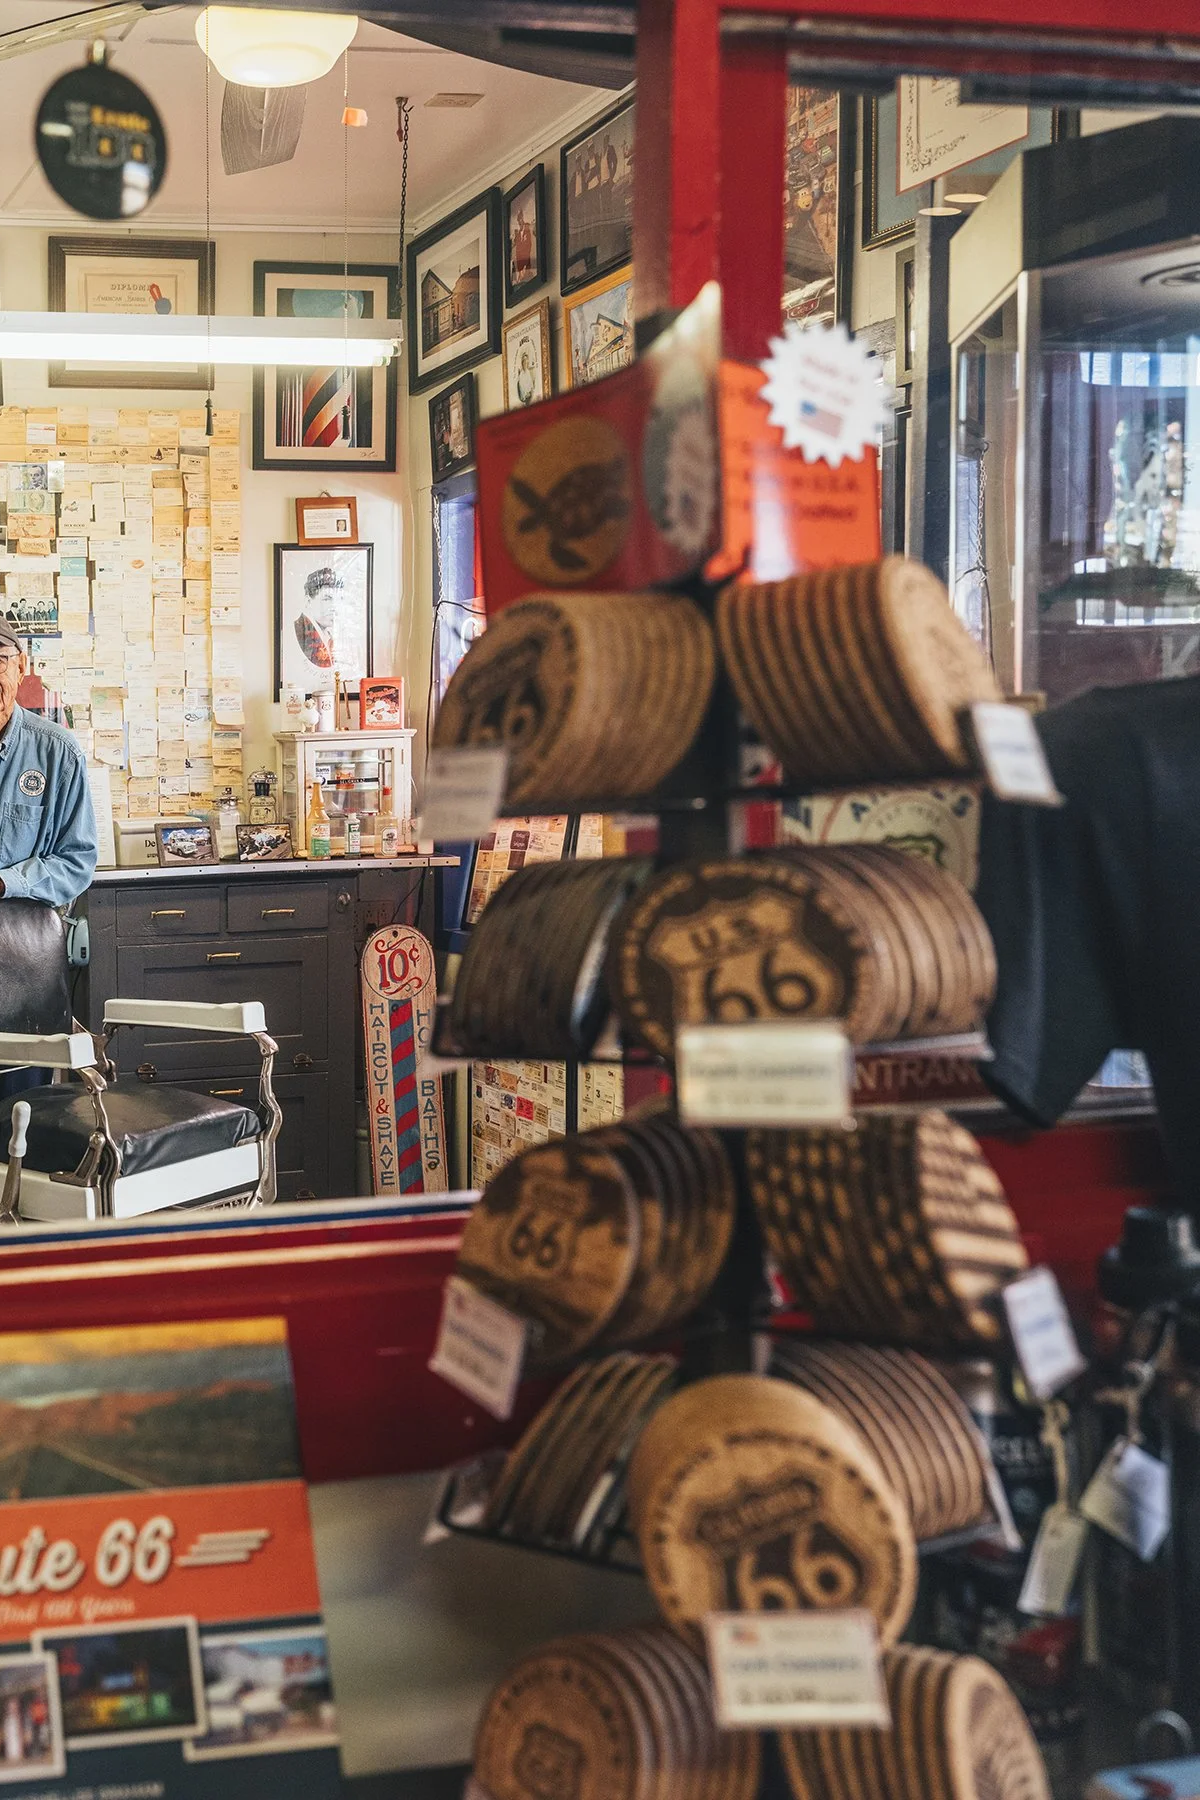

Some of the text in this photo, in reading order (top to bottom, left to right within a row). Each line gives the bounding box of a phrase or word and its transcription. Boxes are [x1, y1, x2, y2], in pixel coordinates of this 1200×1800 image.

[377, 943, 420, 991] 10¢
[369, 1003, 396, 1186] HAIRCUT & SHAVE
[415, 1007, 441, 1169] HO BATHS
[95, 1515, 175, 1586] 66
